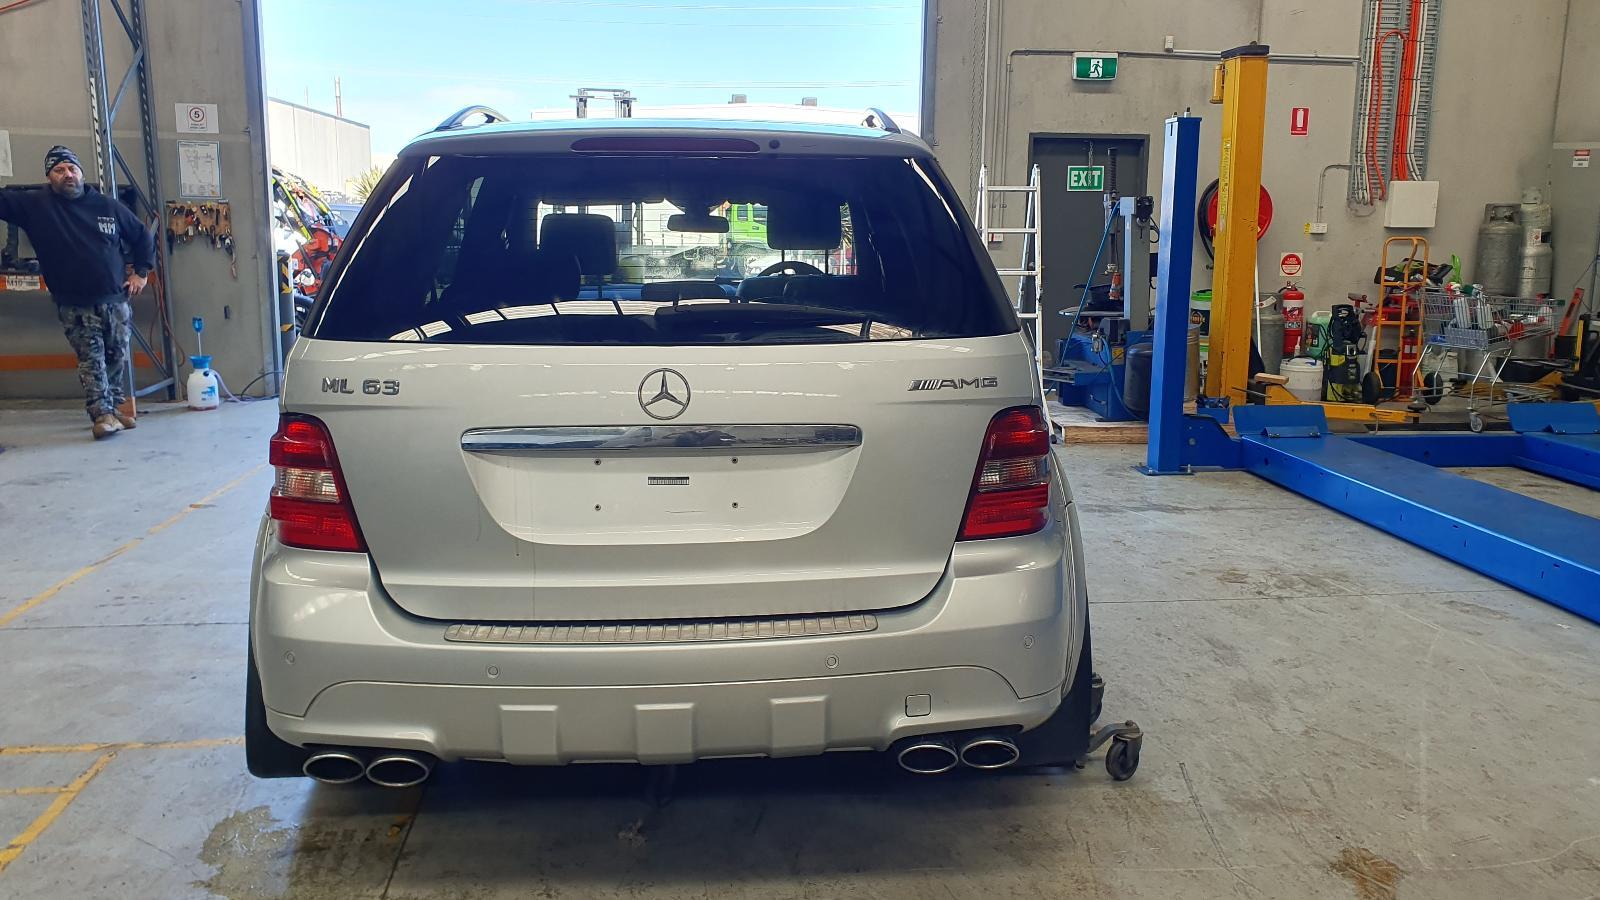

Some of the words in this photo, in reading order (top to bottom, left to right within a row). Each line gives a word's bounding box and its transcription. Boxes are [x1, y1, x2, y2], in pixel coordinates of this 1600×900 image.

[193, 110, 200, 119] 5
[1070, 170, 1101, 187] EXIT
[321, 377, 354, 394] ML
[362, 379, 400, 395] 63
[936, 376, 998, 390] AMG
